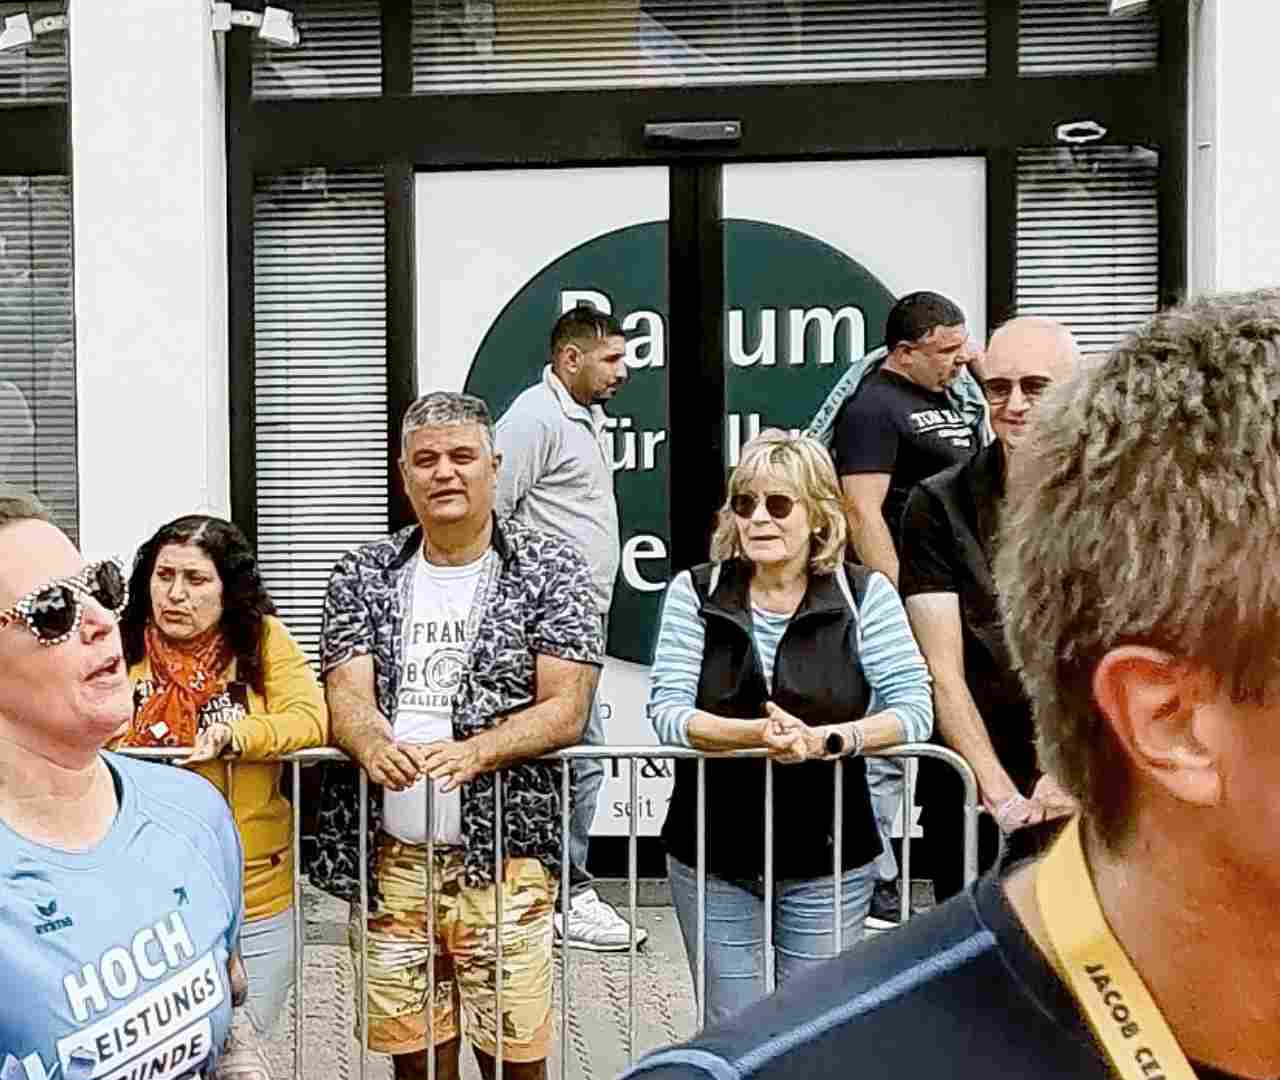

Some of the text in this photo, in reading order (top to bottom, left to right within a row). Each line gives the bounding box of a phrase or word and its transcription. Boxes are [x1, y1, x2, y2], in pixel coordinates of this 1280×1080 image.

[606, 418, 666, 472] ür
[414, 620, 465, 644] FRAN
[62, 910, 195, 1025] HOCH
[1084, 962, 1140, 1039] JACOB
[95, 967, 216, 1063] EISTUNGS
